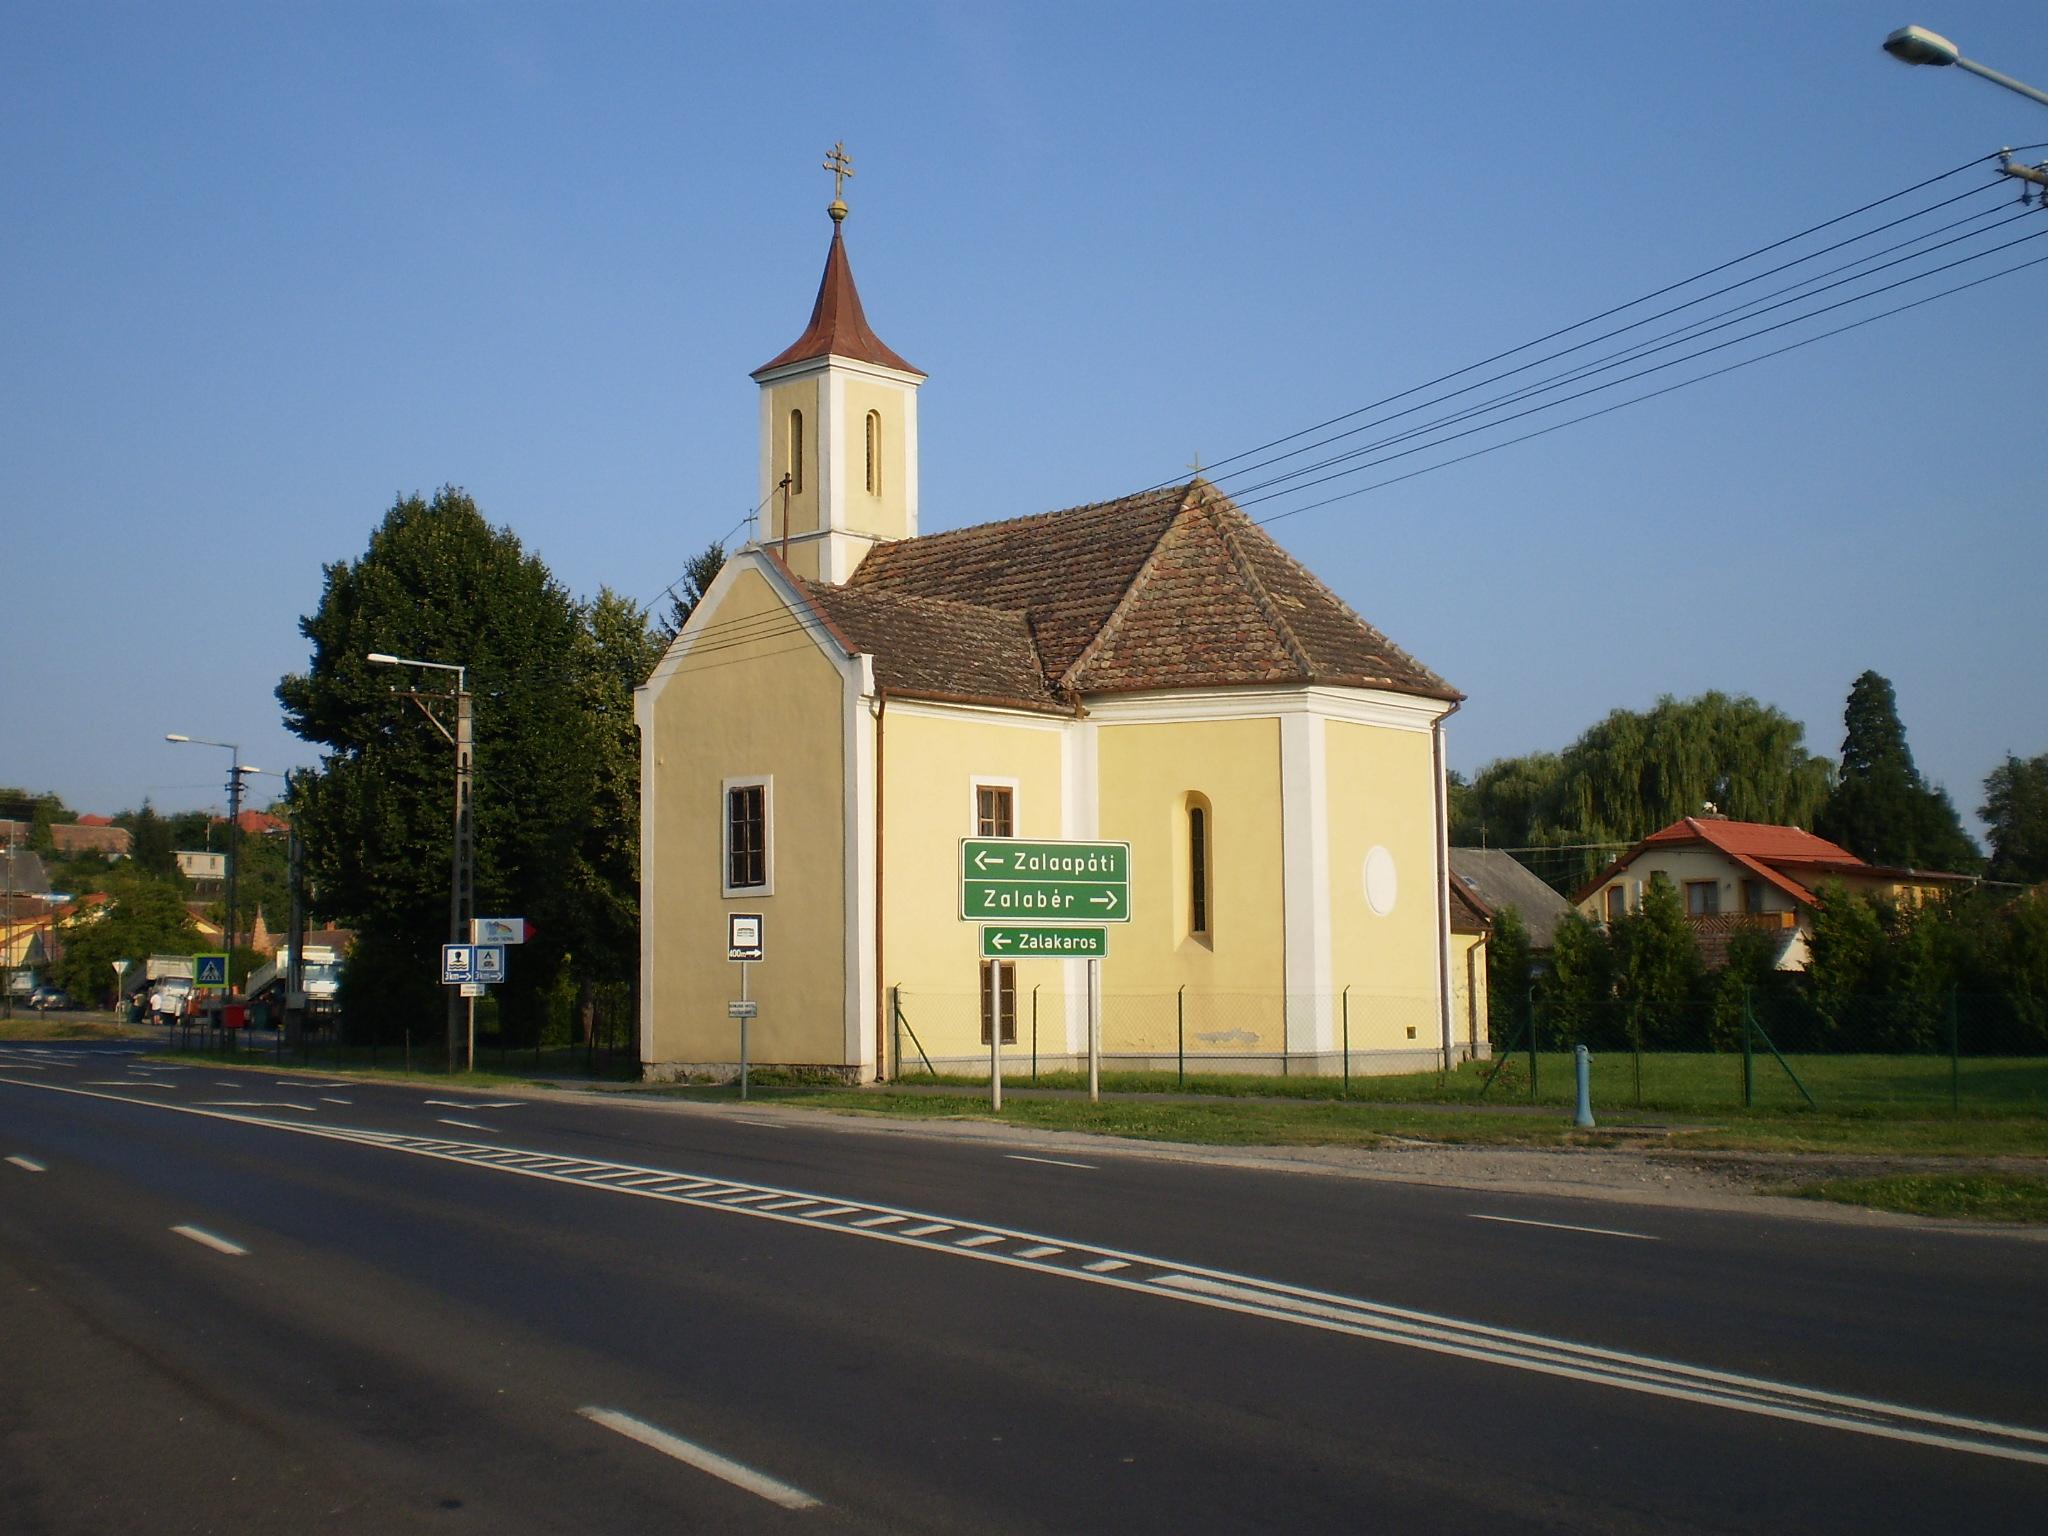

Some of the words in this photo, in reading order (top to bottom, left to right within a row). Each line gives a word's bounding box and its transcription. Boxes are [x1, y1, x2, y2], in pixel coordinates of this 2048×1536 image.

[1014, 853, 1115, 875] Zalaapáti
[984, 889, 1075, 908] Zalabér
[1019, 934, 1097, 949] Zalakaros
